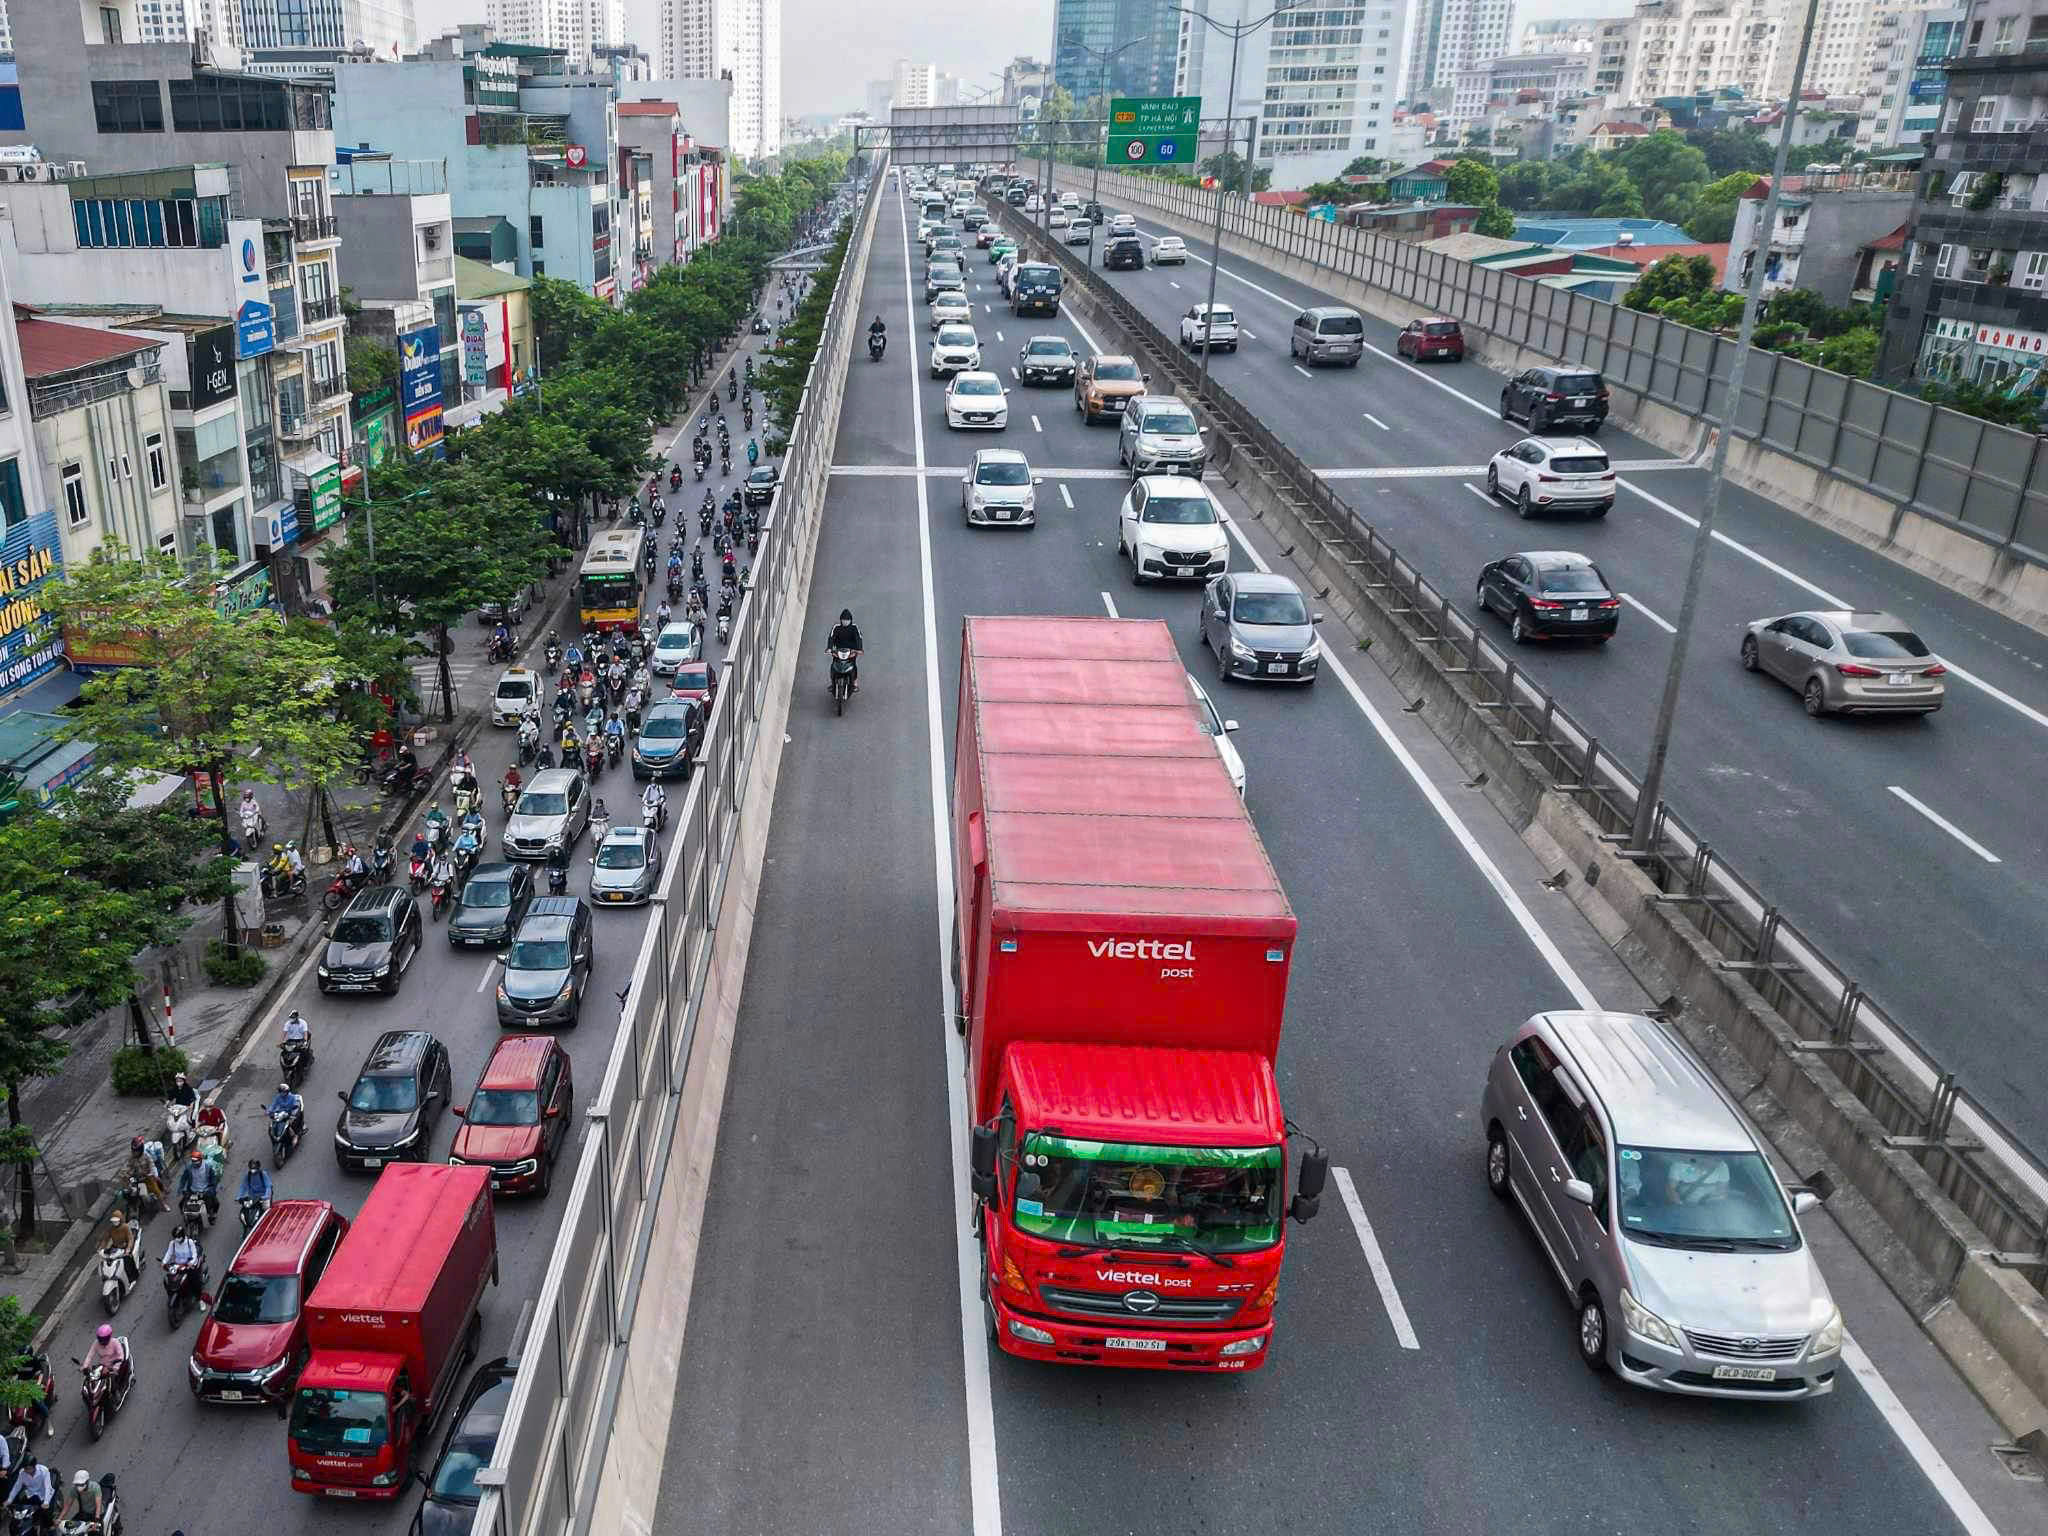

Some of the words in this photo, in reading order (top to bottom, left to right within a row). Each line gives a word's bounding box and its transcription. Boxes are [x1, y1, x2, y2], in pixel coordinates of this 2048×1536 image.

[1161, 144, 1174, 155] 60
[1087, 937, 1197, 961] viettel
[1160, 967, 1194, 980] post
[1096, 1269, 1162, 1286] viettel
[1164, 1278, 1193, 1289] post
[340, 1312, 385, 1324] viettel
[316, 1459, 347, 1467] viettel
